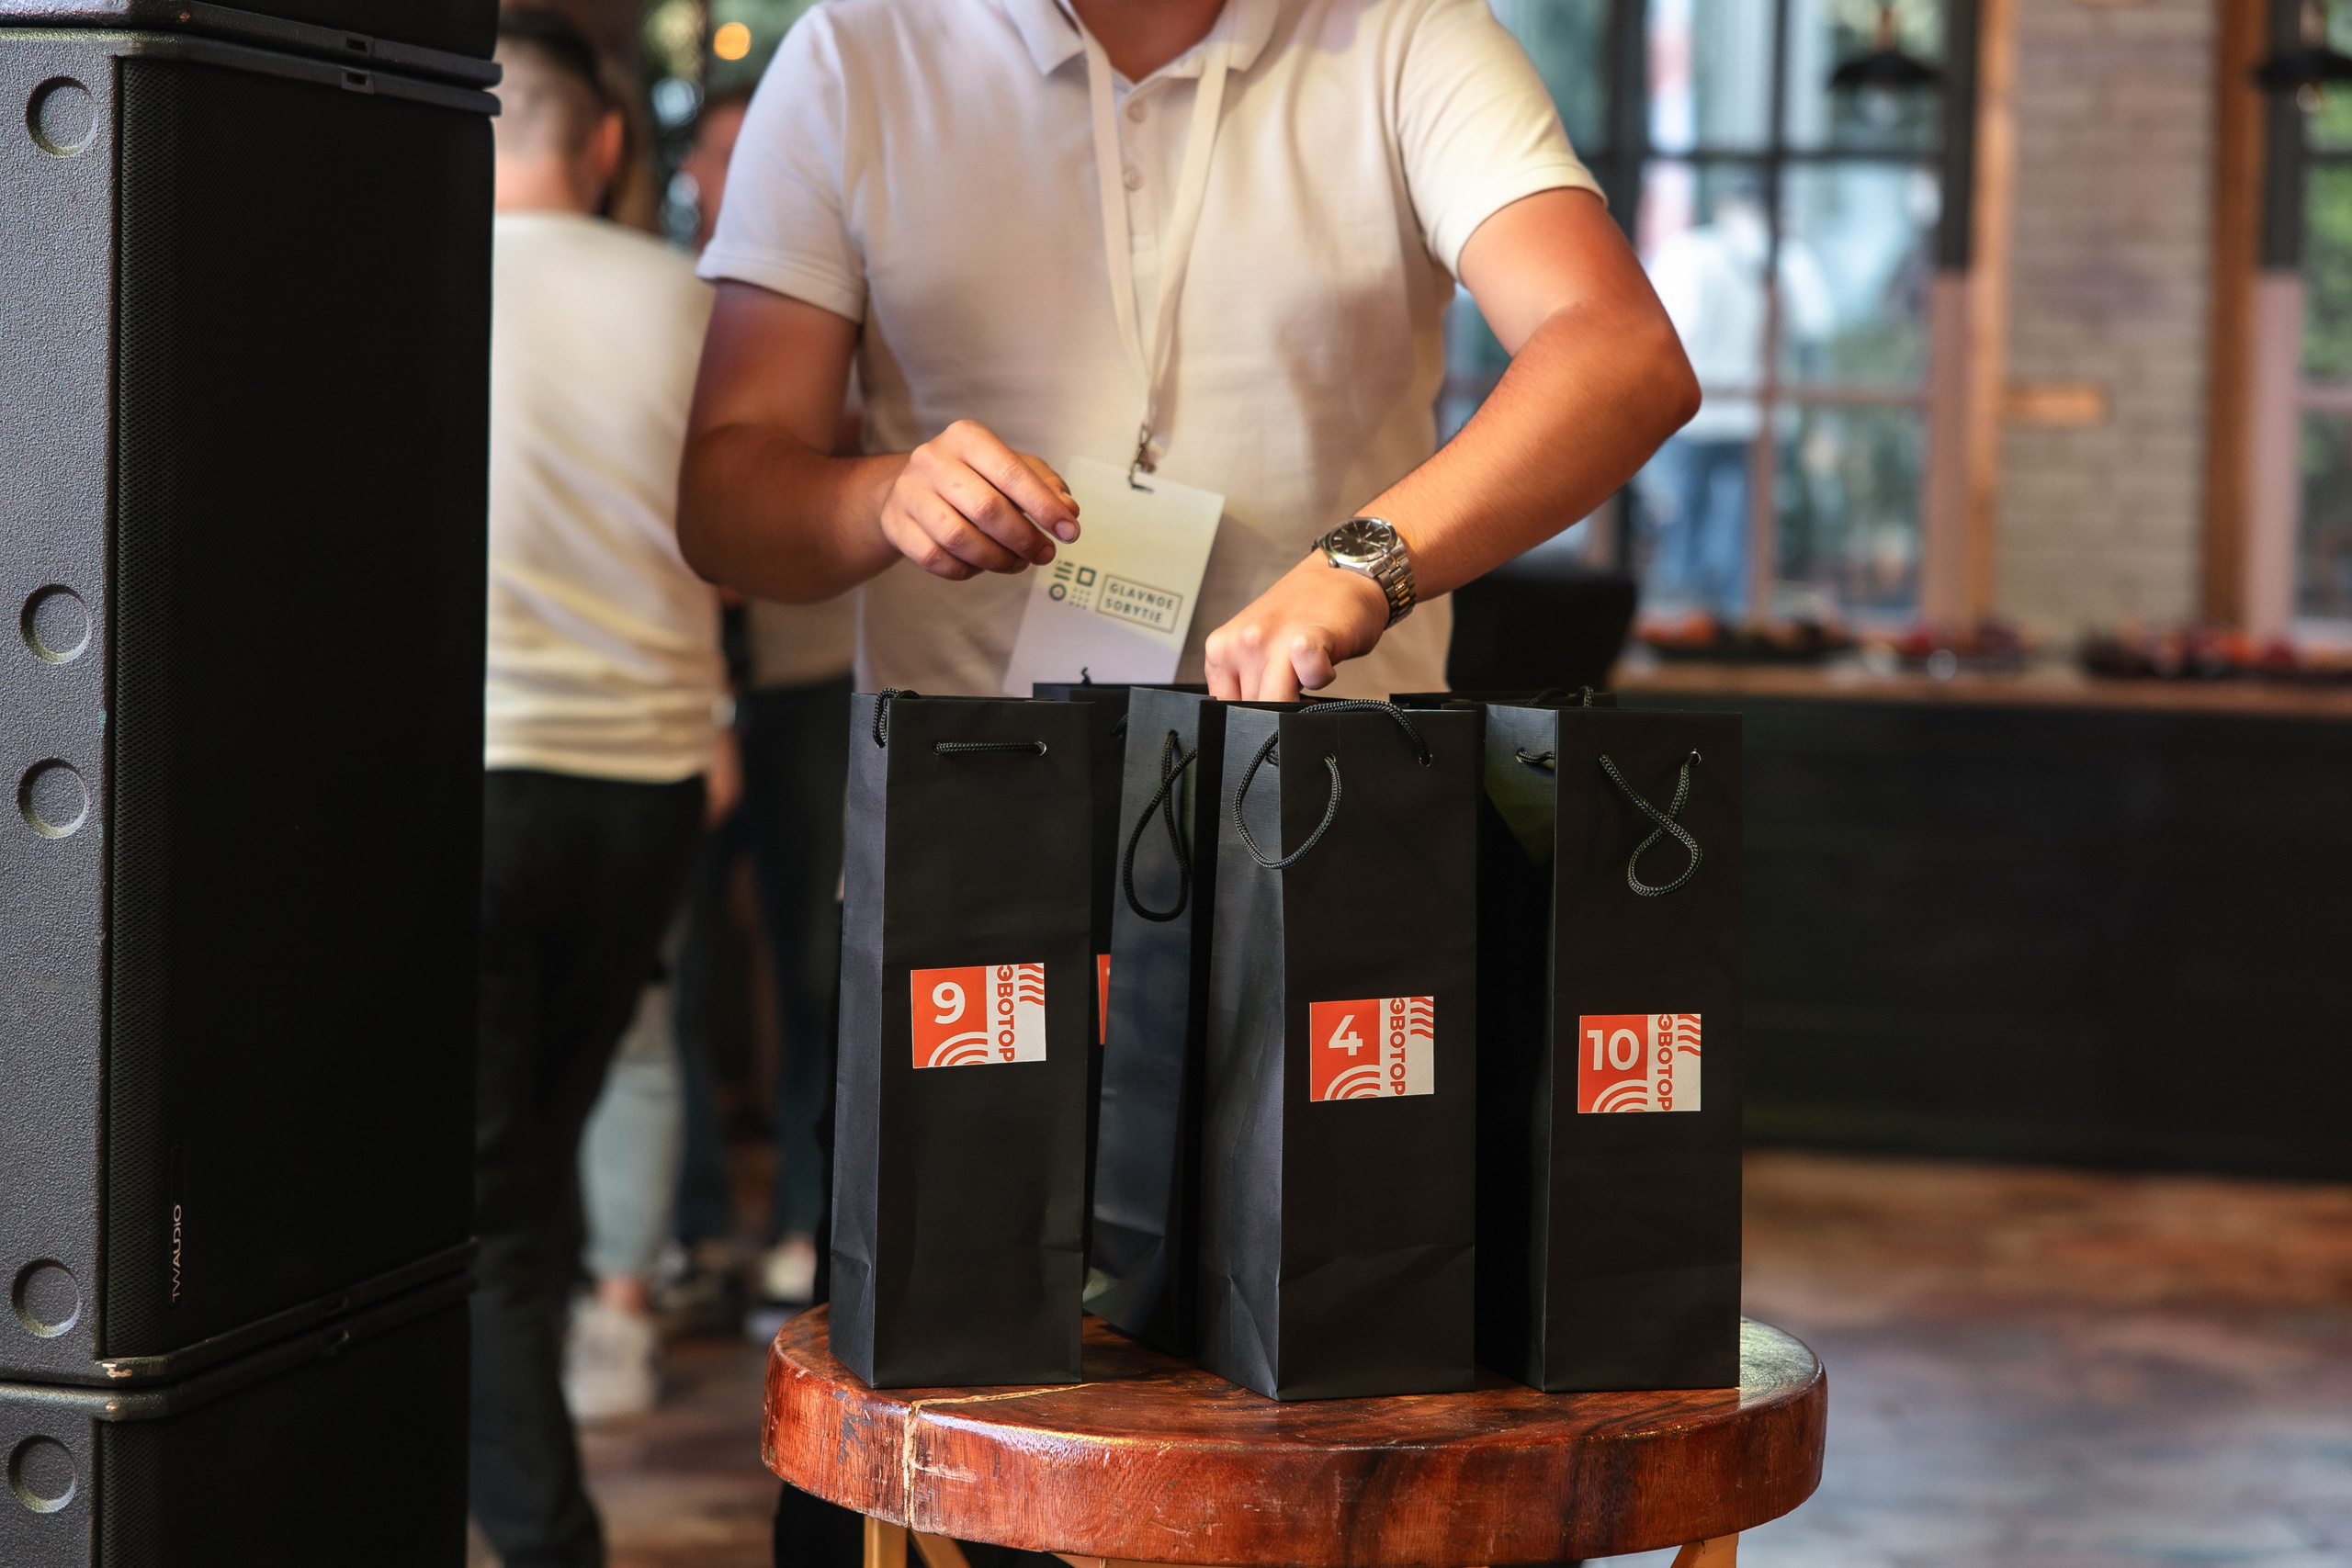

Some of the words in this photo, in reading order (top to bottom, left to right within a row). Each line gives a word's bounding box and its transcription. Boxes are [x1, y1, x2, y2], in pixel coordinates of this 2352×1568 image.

[1105, 598, 1162, 623] SOBYTIE
[1109, 582, 1174, 610] GLAVNOE
[932, 981, 966, 1024] 9
[997, 964, 1015, 1062] ЭВОТОР
[1328, 1014, 1363, 1056] 4
[1389, 998, 1406, 1096] ЭВОТОР
[1587, 1028, 1640, 1071] 10
[1657, 1014, 1673, 1111] ЭВОТОР
